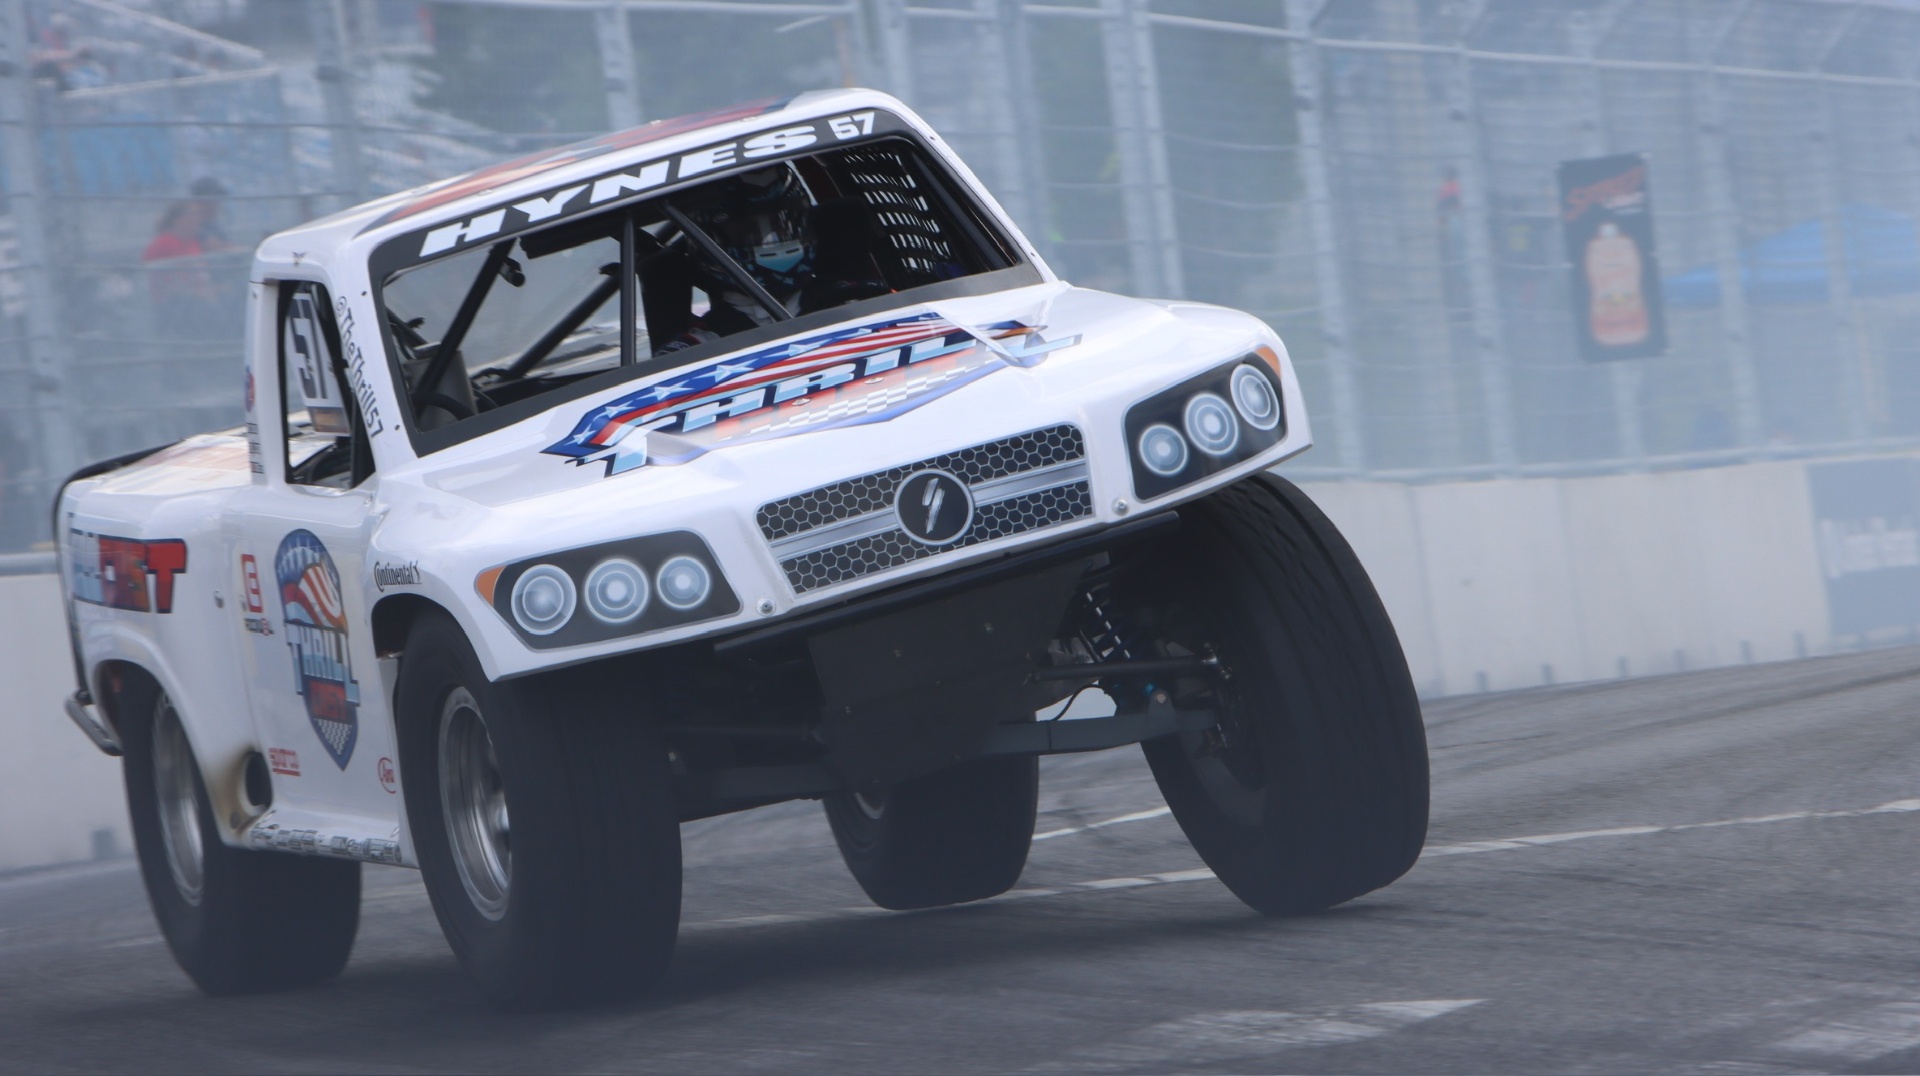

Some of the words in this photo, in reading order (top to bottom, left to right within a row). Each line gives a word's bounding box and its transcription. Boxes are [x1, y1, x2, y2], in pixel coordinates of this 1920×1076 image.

[419, 125, 817, 257] HYNES
[828, 112, 875, 141] 57
[335, 295, 384, 439] @TheThrill57
[565, 330, 1083, 478] THRILL
[373, 560, 415, 593] Continental
[284, 620, 361, 707] THRILL
